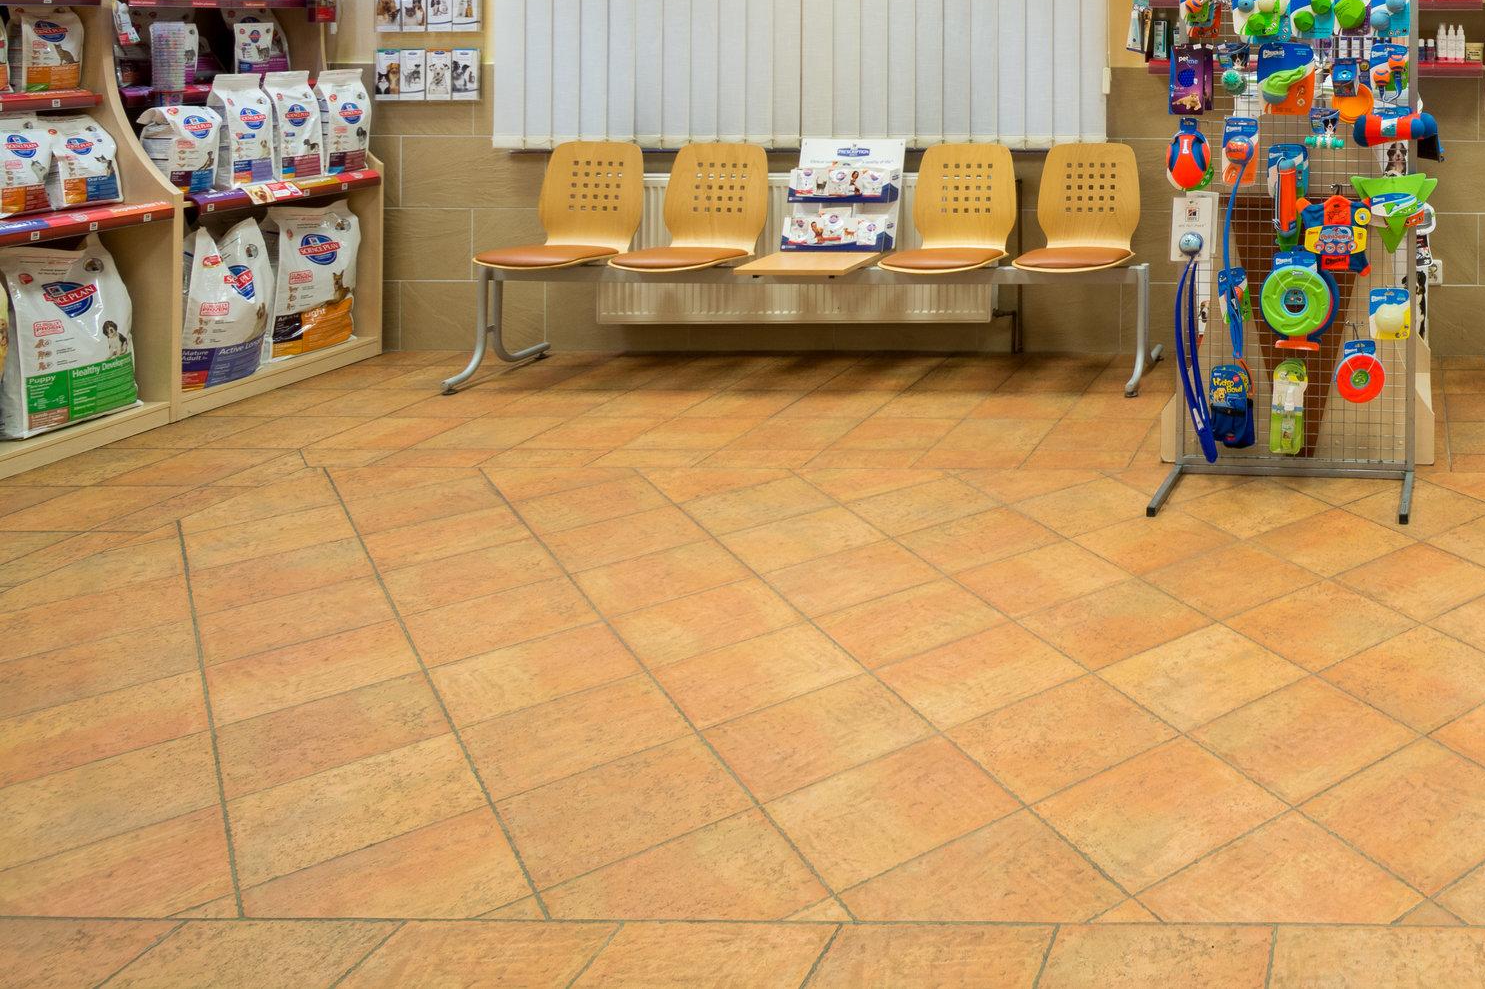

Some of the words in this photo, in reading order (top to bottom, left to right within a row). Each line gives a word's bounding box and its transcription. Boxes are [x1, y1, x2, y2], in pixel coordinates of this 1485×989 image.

[70, 286, 95, 301] PLAN
[218, 344, 244, 356] Active
[72, 363, 100, 378] Healthy
[29, 375, 56, 386] Puppy
